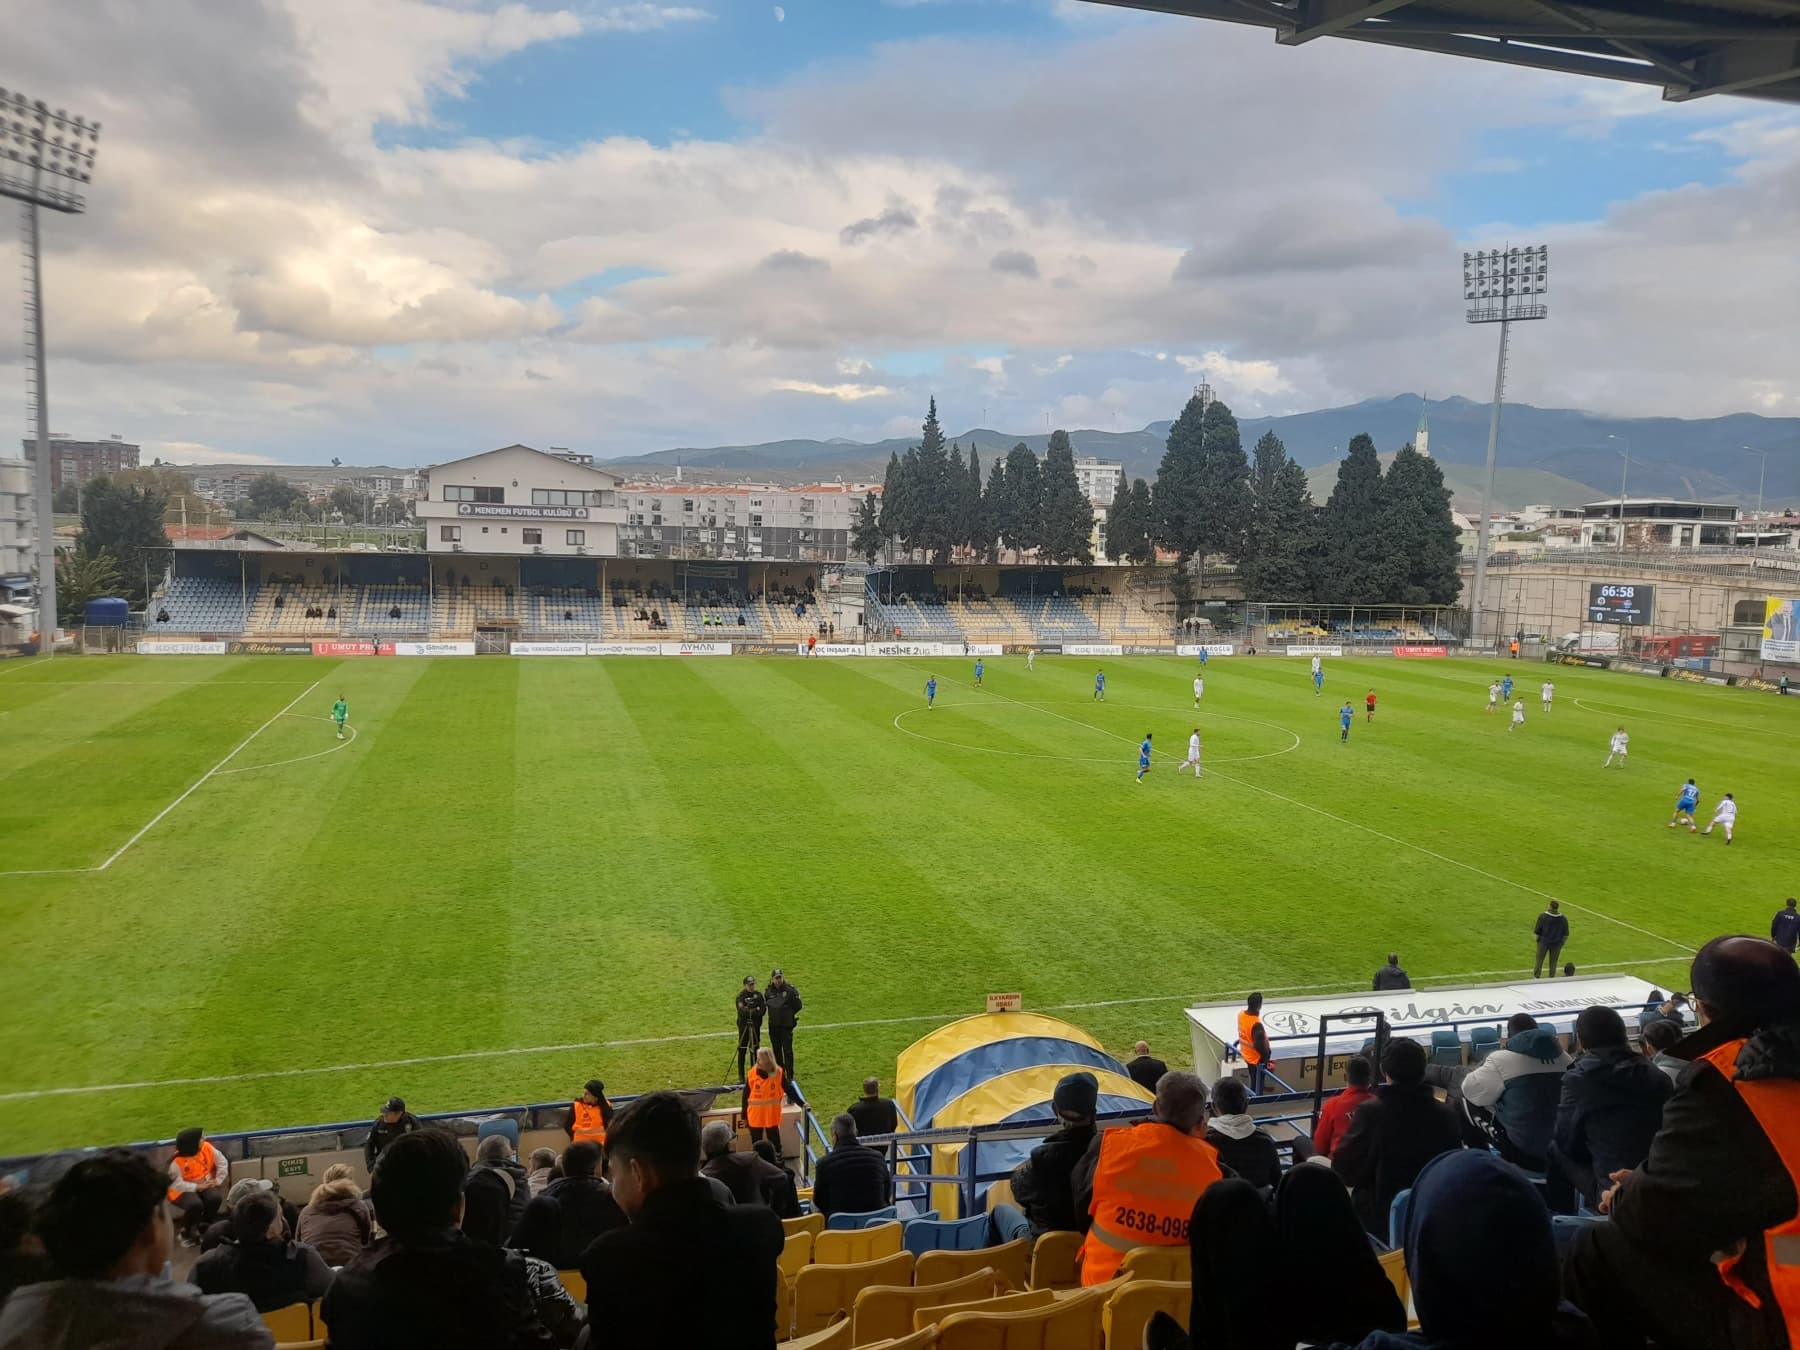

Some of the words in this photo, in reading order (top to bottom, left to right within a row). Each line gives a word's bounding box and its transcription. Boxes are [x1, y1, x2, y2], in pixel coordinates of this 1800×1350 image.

[474, 506, 512, 515] MENEMEN
[512, 507, 542, 516] FUTBOL
[542, 508, 573, 517] KULÜBÜ
[1601, 585, 1634, 598] 66:58
[1596, 612, 1603, 621] 0
[246, 643, 283, 653] Bilgin
[331, 642, 356, 651] UMUT
[359, 642, 392, 651] PRFİL
[680, 643, 715, 651] AYHAN
[879, 644, 911, 655] NESİNE
